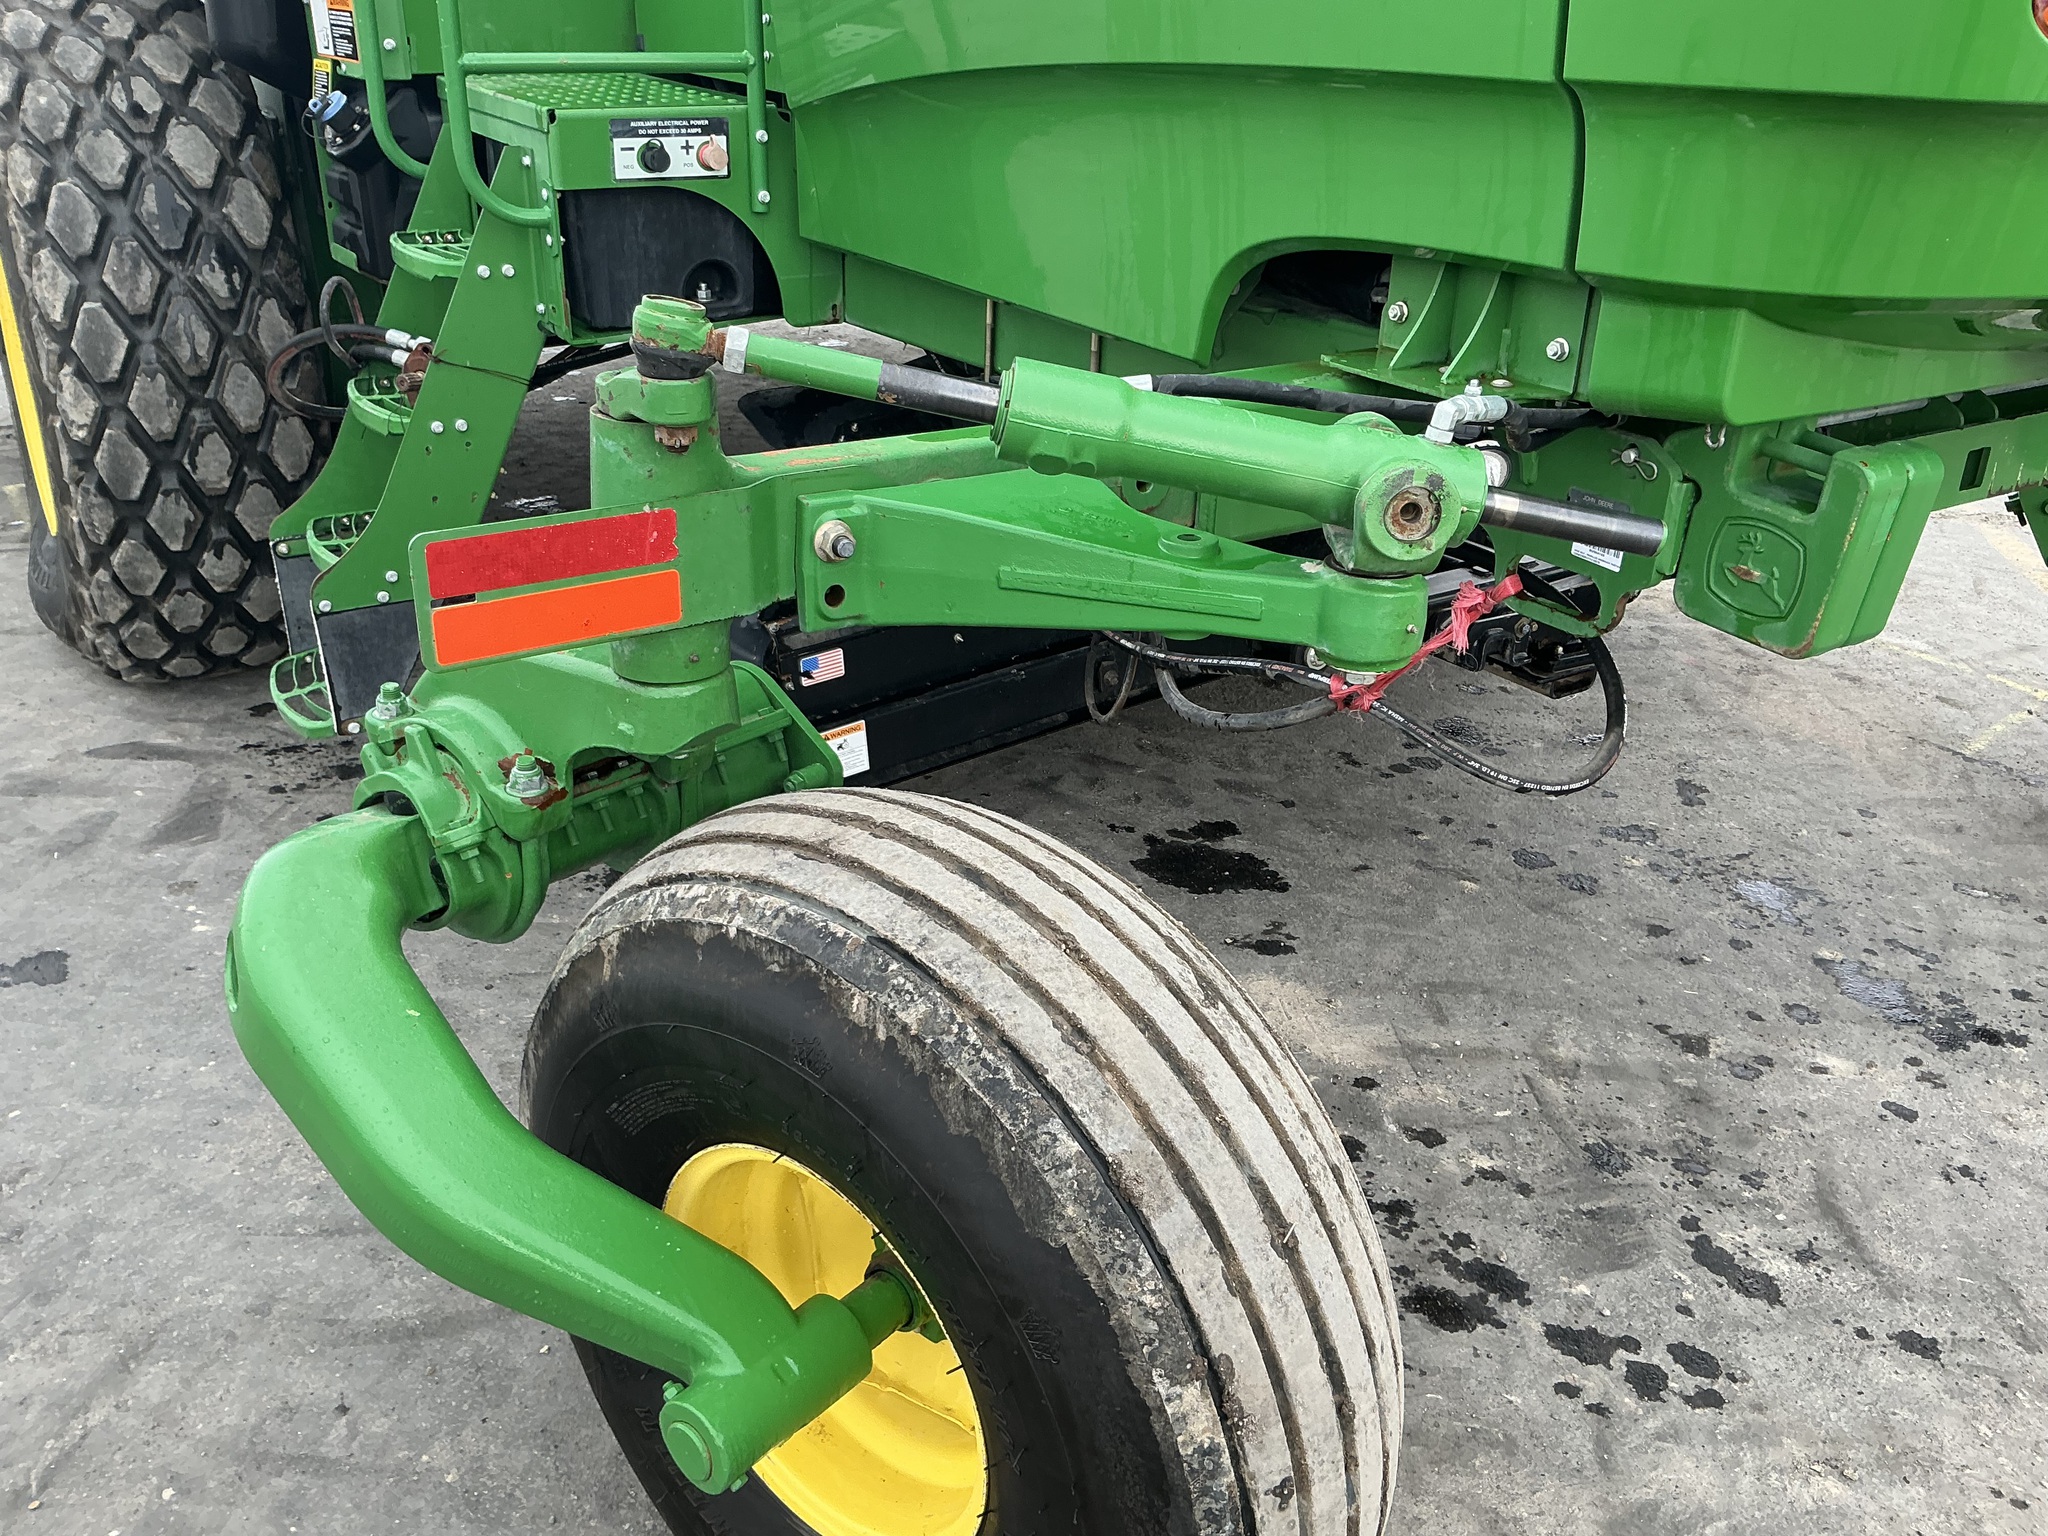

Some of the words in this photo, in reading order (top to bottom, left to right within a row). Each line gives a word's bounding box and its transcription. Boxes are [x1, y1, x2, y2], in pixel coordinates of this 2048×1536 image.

[1583, 495, 1596, 504] JOHN
[1597, 500, 1614, 510] DEERE
[830, 724, 861, 740] WARNING
